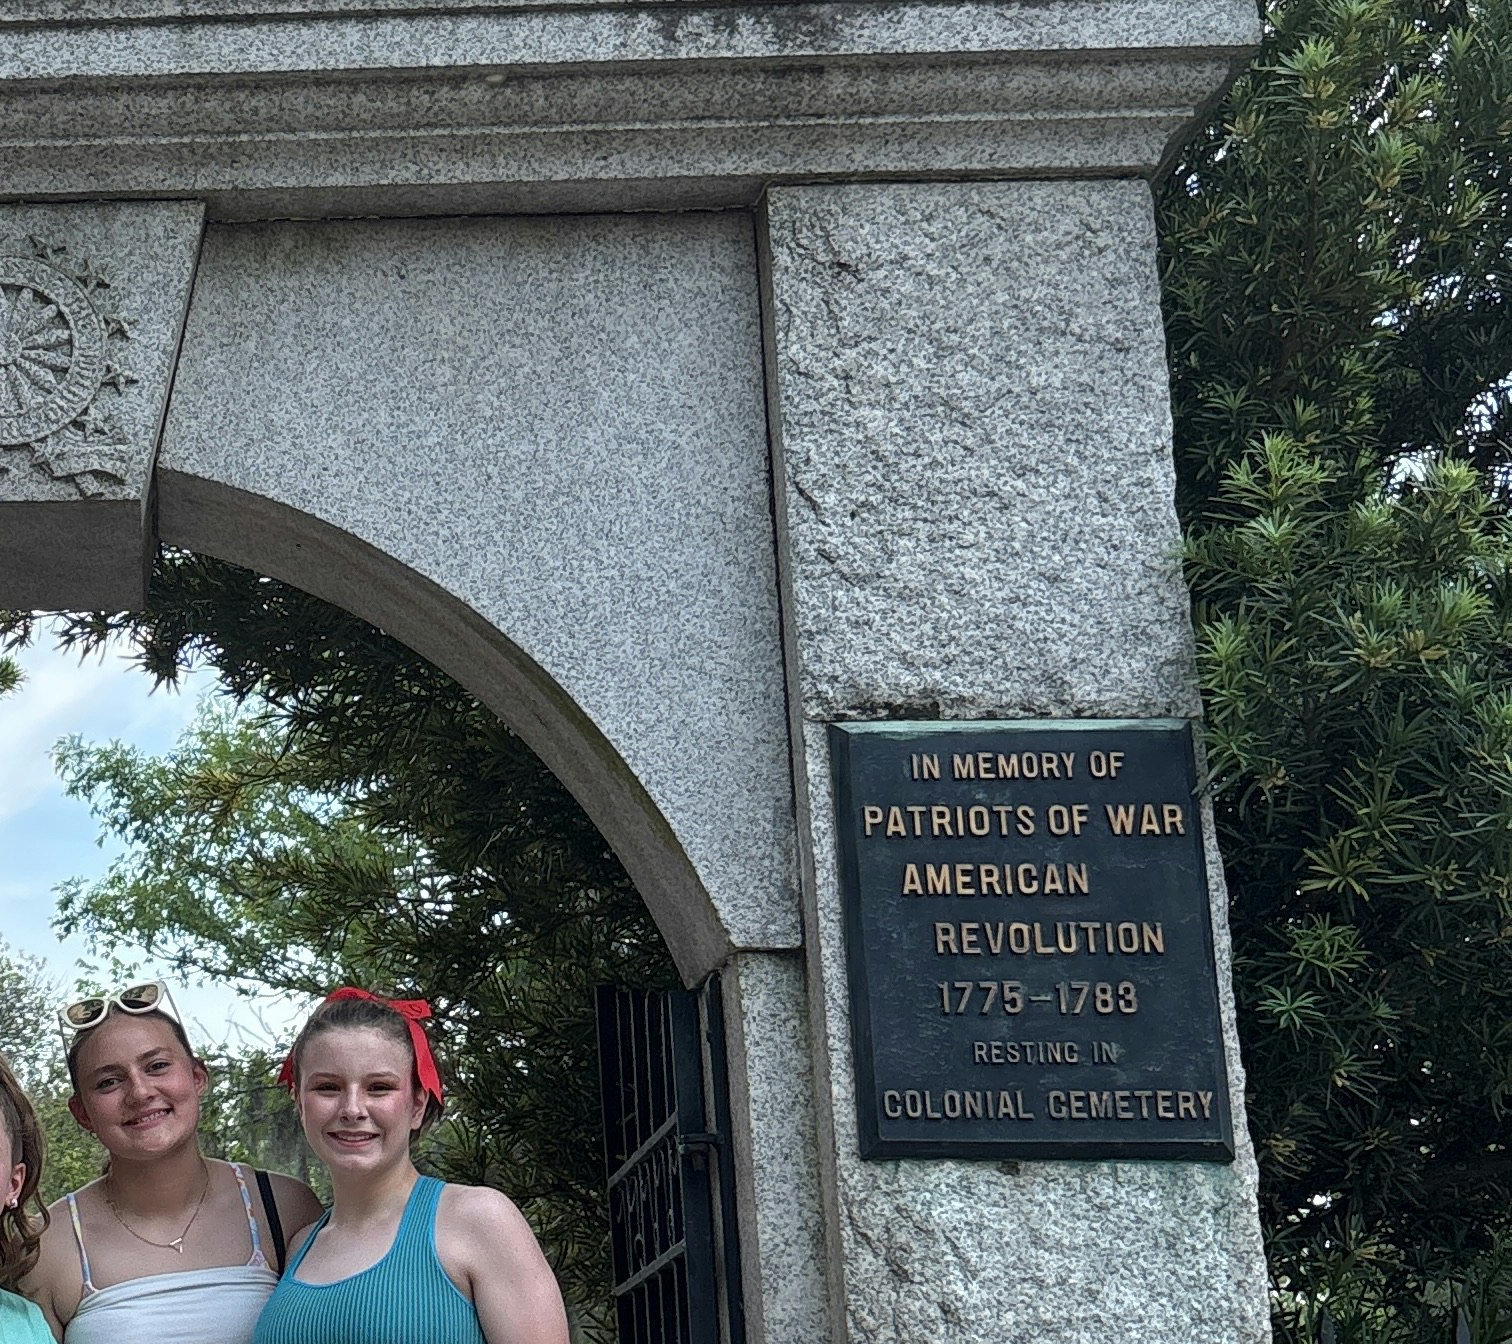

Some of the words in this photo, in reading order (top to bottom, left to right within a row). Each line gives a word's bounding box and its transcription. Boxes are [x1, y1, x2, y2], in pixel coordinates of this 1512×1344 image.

[911, 753, 941, 779] IN
[953, 751, 1076, 779] MEMORY
[1089, 751, 1125, 777] OF
[863, 805, 1036, 837] PATRIOTS
[1048, 804, 1089, 836] OF
[1106, 804, 1186, 836] WAR
[902, 864, 1089, 896] AMERICAN
[935, 922, 1165, 955] REVOLUTION
[973, 1041, 1079, 1064] RESTING
[1091, 1041, 1120, 1063] IN
[883, 1090, 1035, 1120] COLONIAL
[1047, 1090, 1214, 1120] CEMETERY
